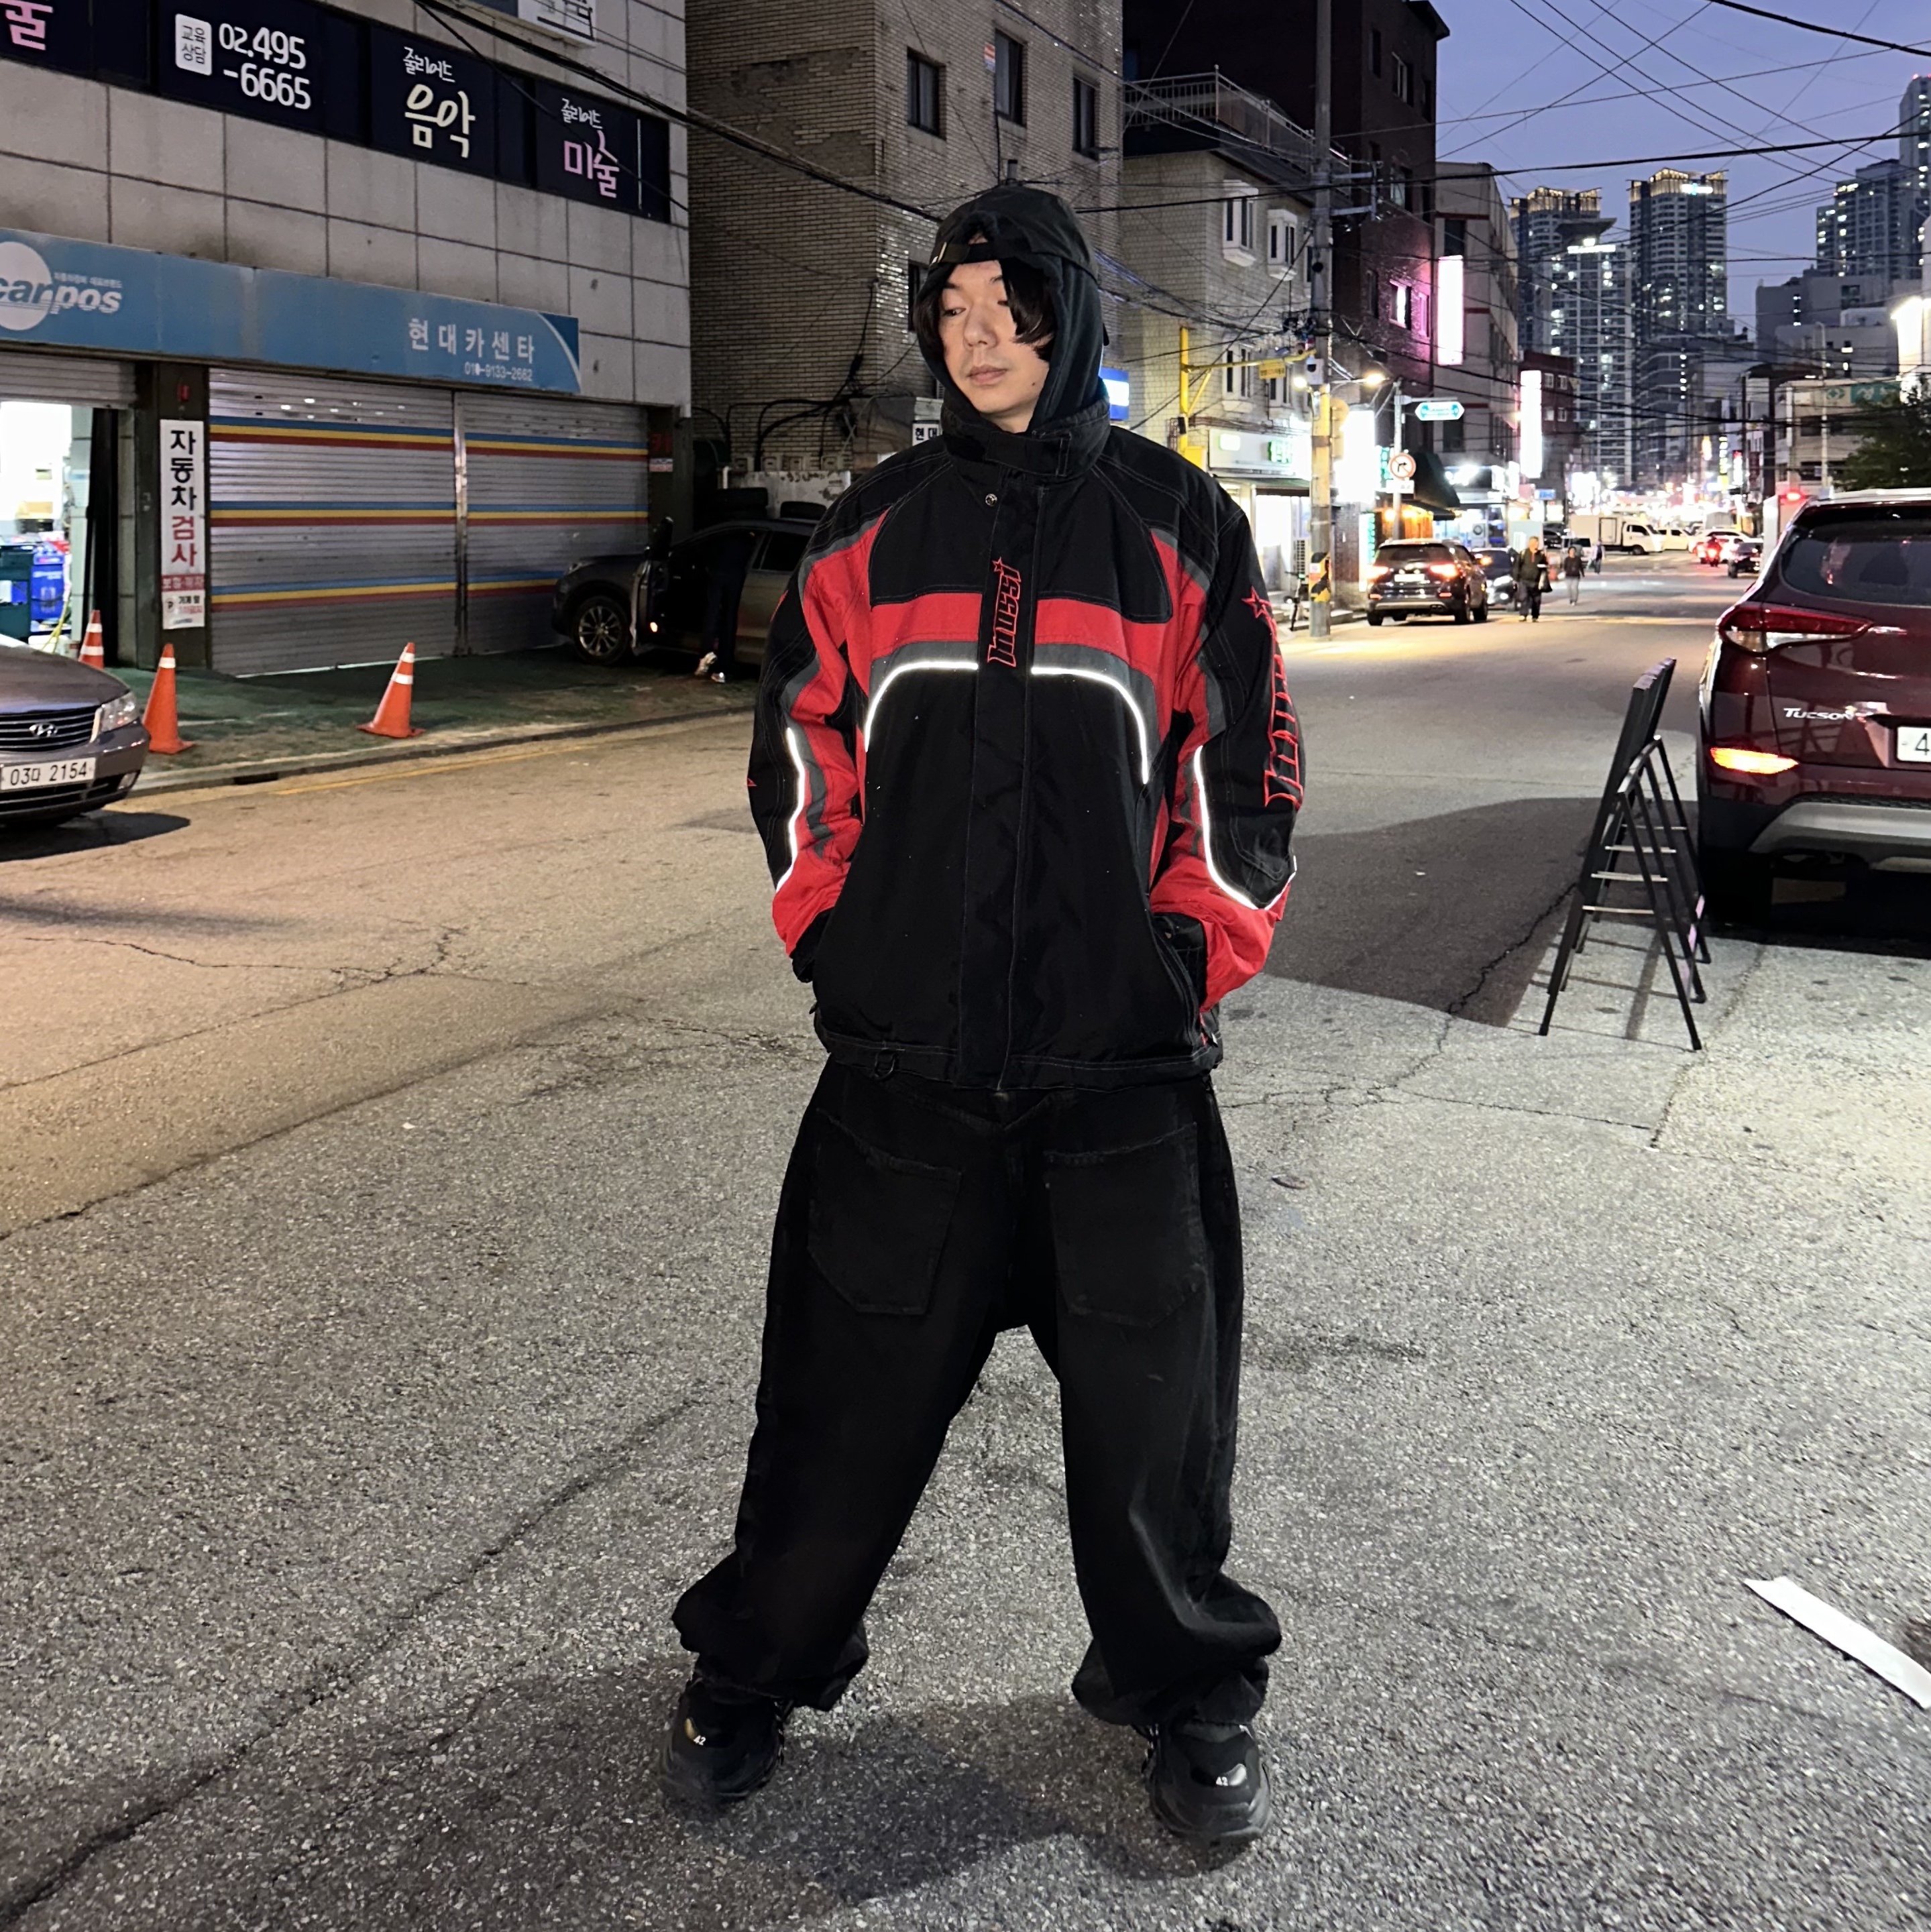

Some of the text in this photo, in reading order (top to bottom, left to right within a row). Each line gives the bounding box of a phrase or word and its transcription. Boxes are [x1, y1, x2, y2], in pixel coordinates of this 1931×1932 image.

[182, 43, 207, 65] 상담
[219, 23, 307, 69] 02.495
[223, 62, 311, 109] -6665
[404, 84, 476, 158] 음악
[563, 129, 620, 198] 미술
[49, 761, 87, 782] 2154
[1215, 1776, 1229, 1786] 42
